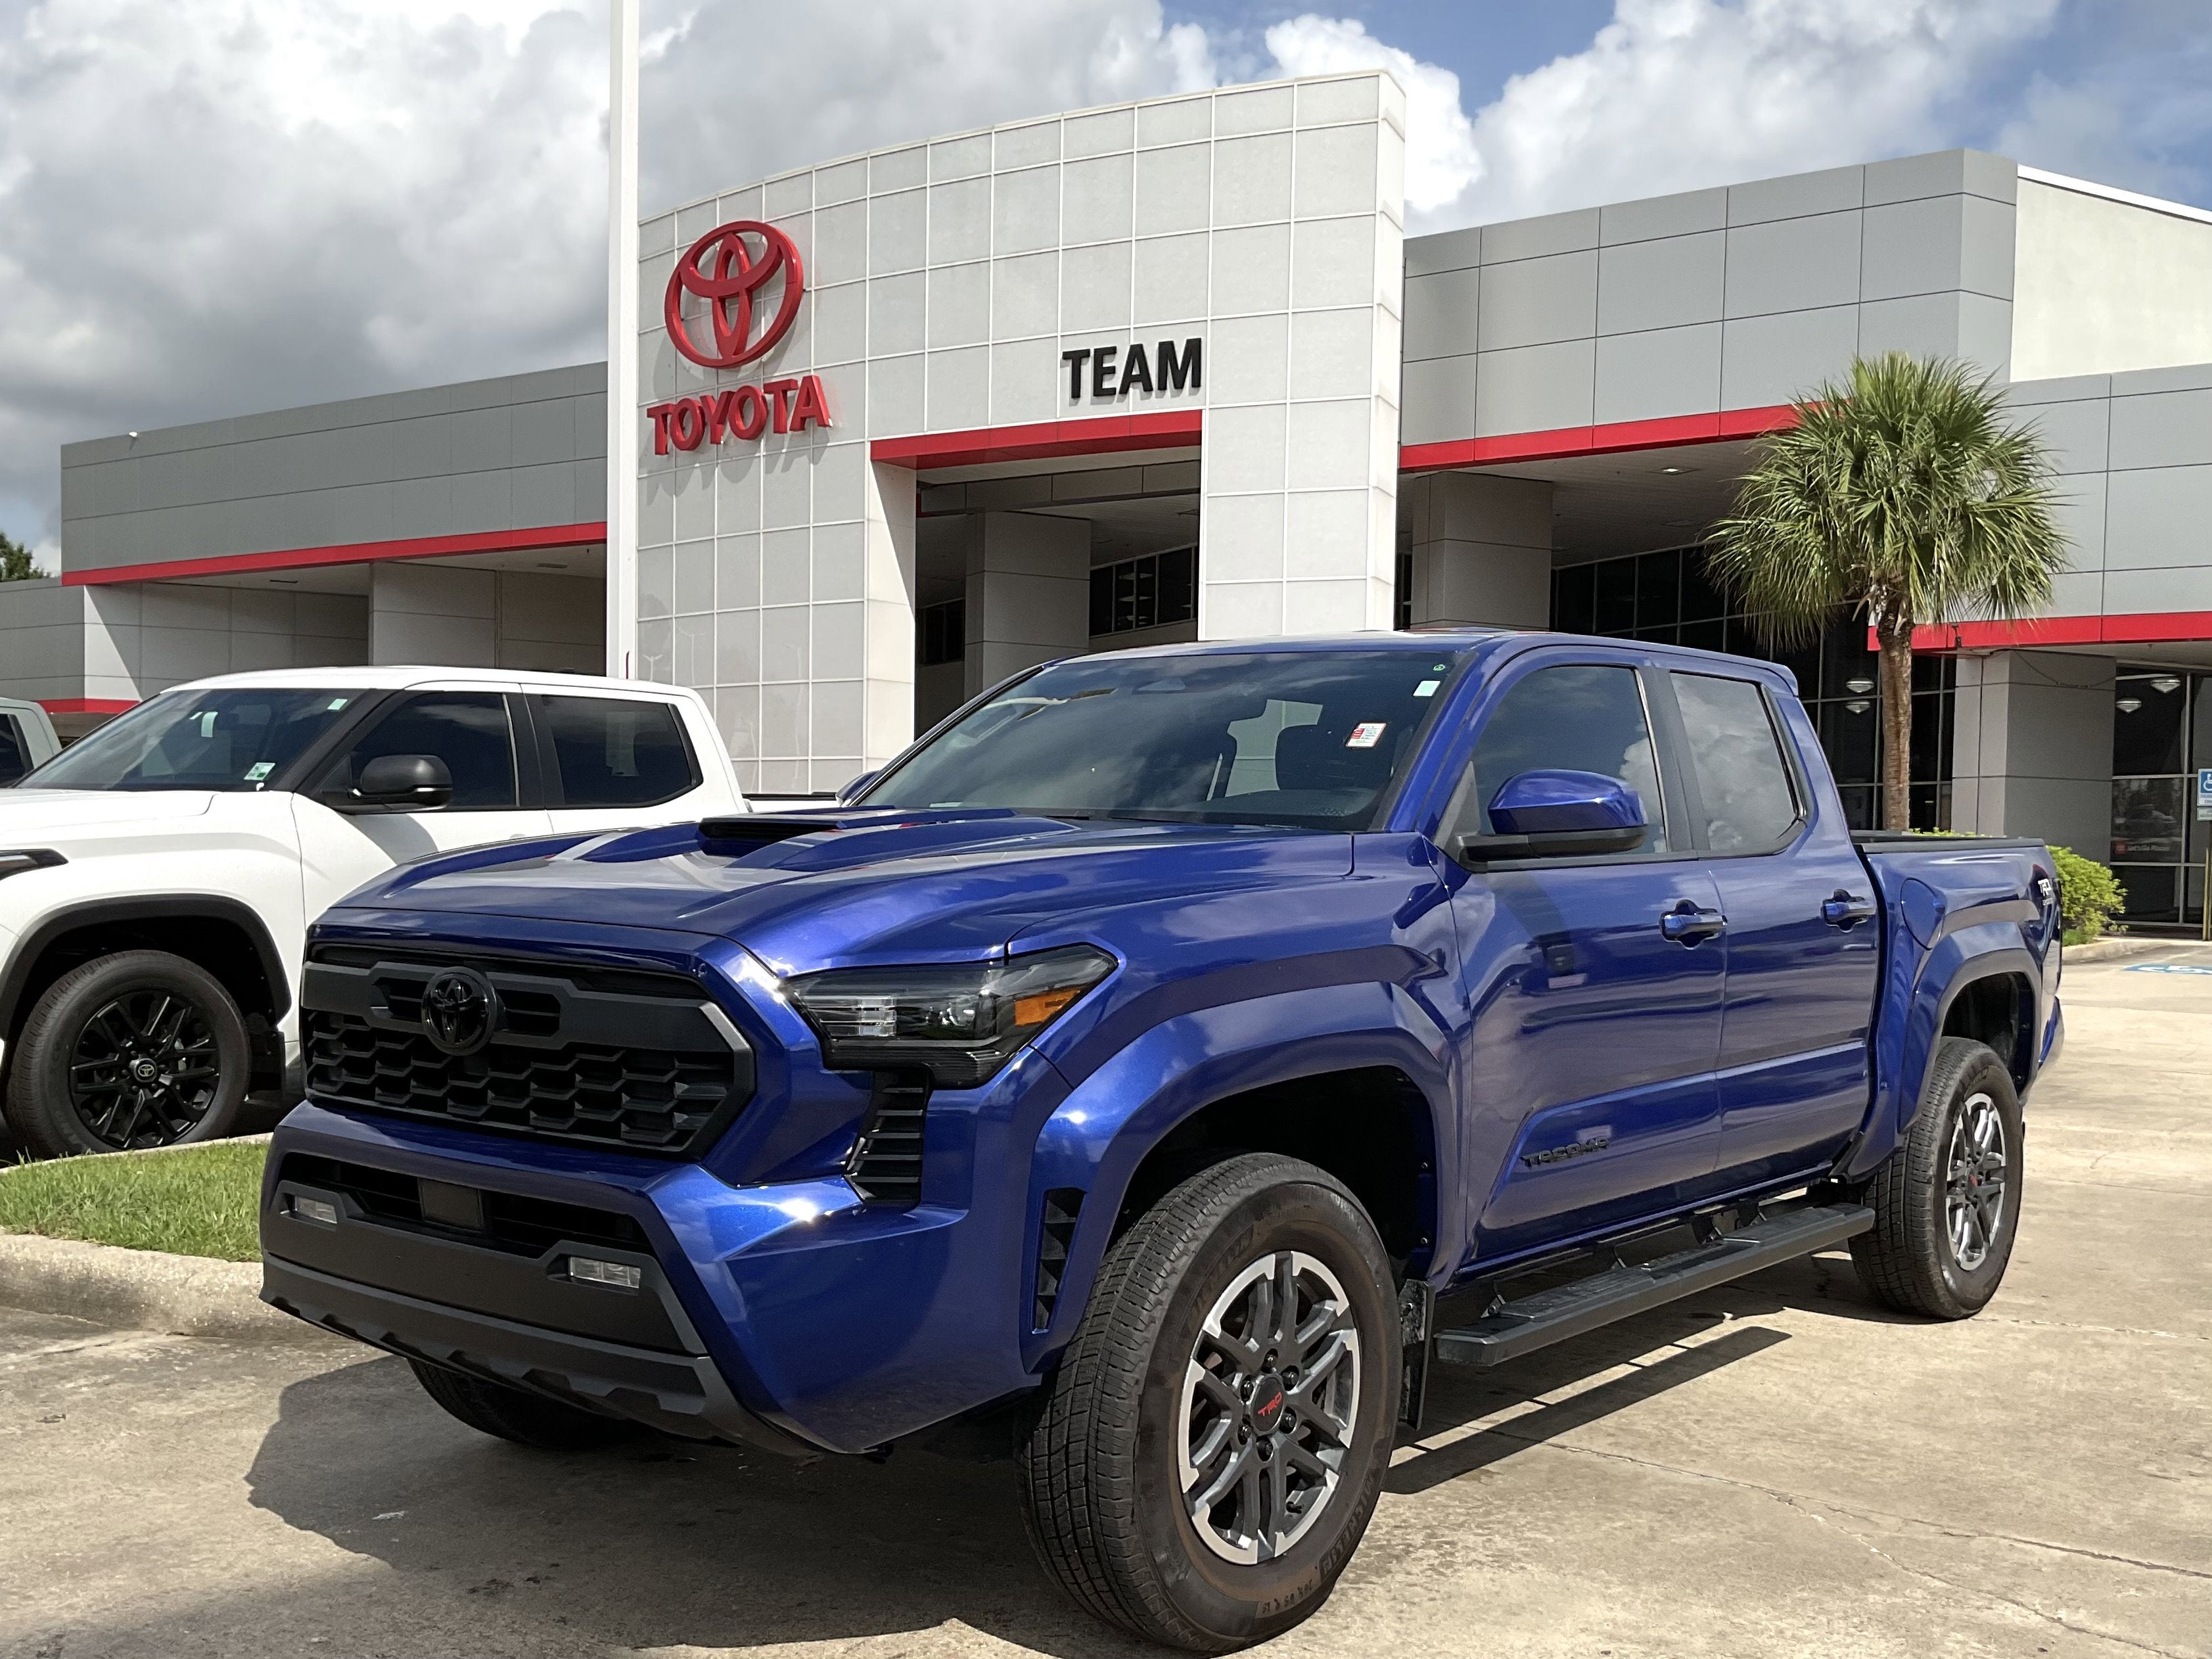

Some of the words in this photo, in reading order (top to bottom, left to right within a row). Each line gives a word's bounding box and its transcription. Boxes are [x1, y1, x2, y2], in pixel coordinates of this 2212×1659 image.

[1062, 337, 1202, 399] TEAM
[647, 375, 833, 456] TOYOTA
[1257, 1391, 1282, 1417] TRD
